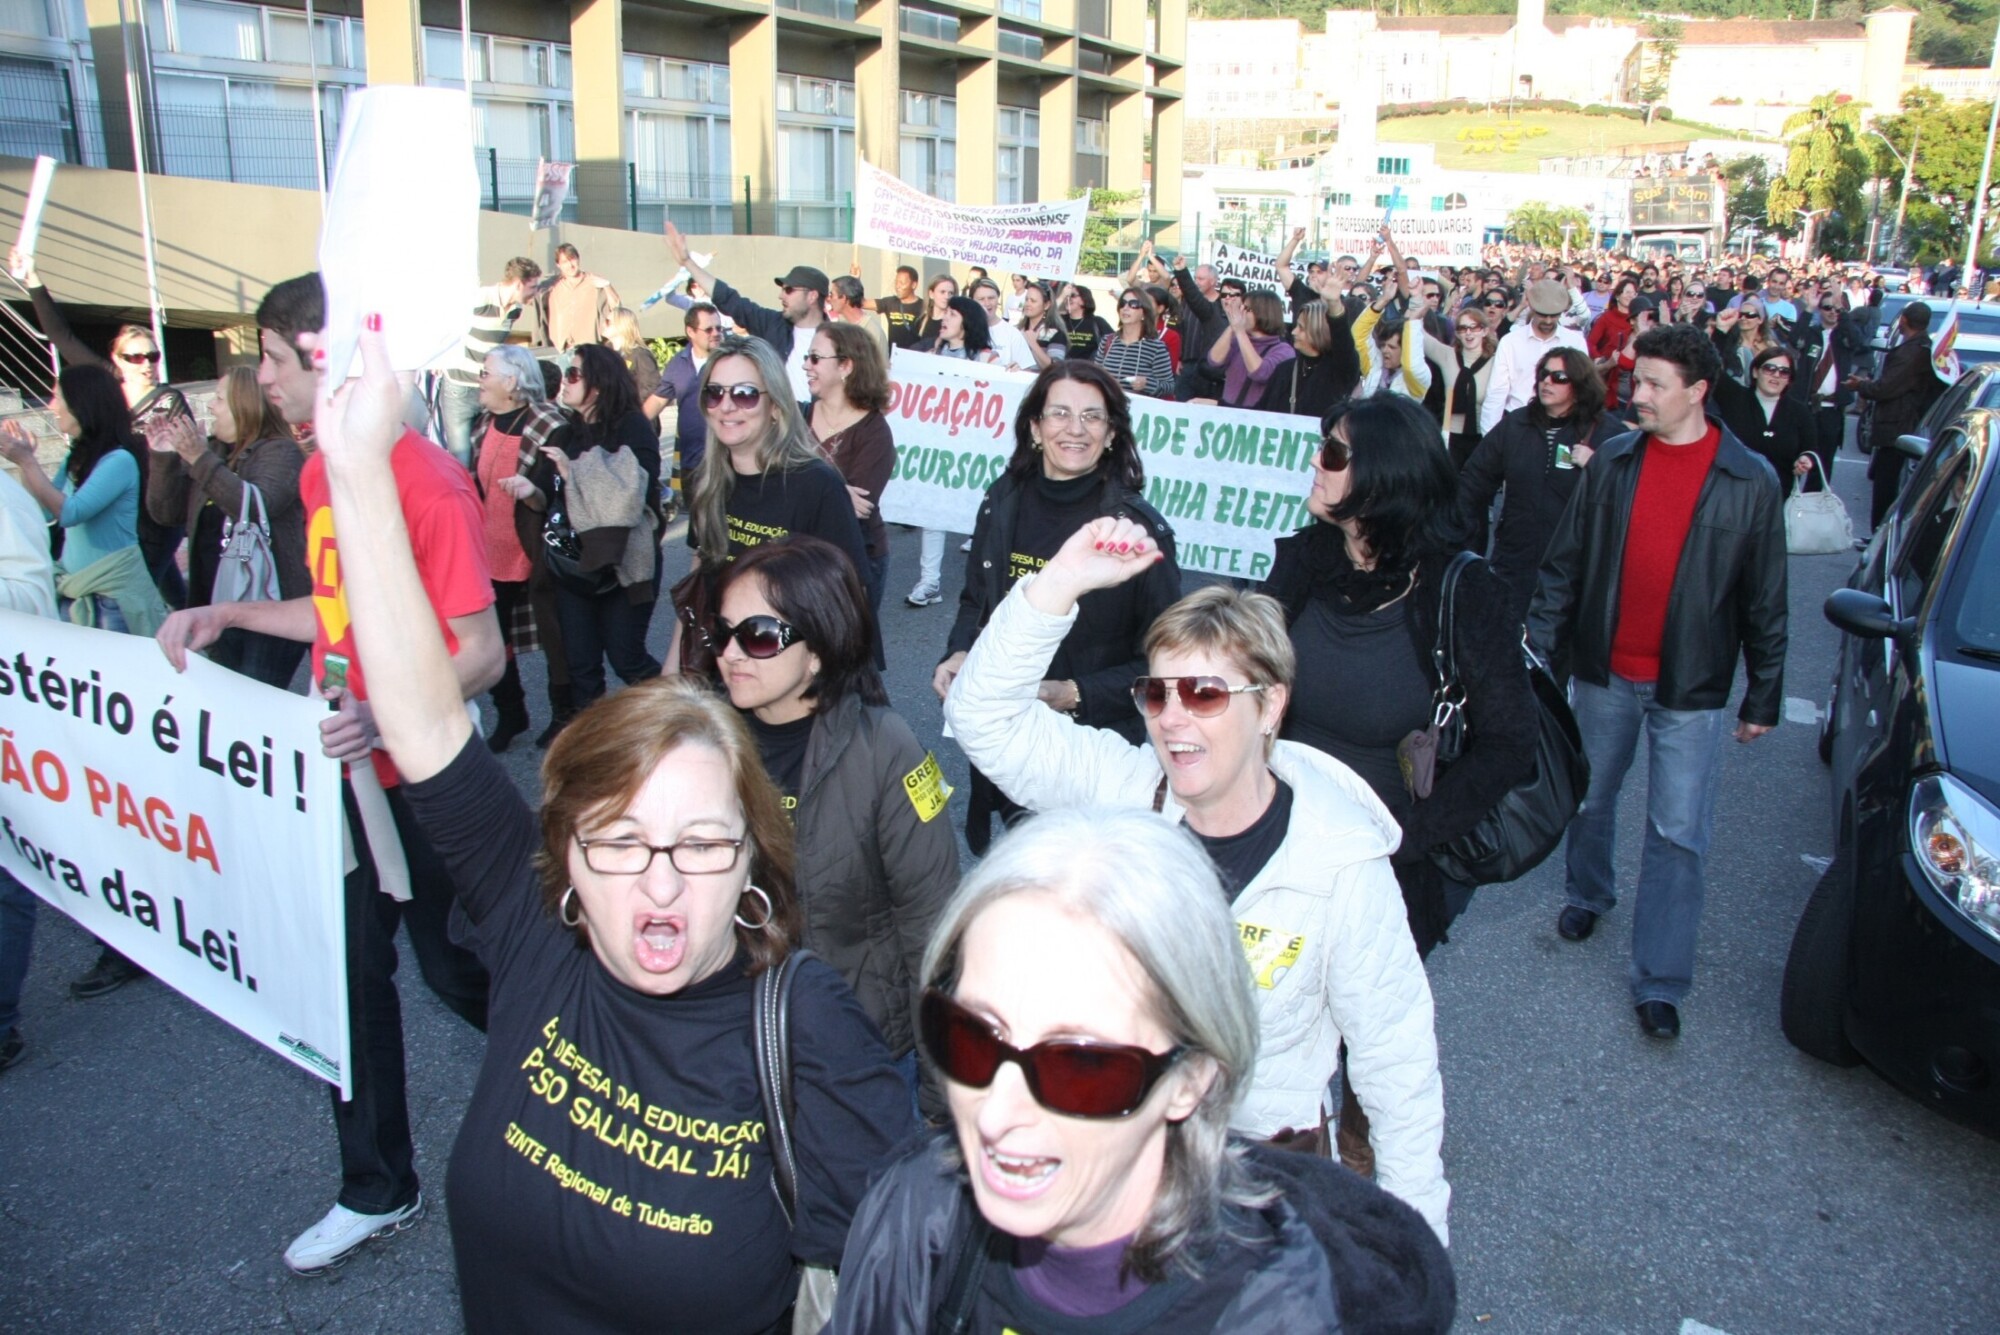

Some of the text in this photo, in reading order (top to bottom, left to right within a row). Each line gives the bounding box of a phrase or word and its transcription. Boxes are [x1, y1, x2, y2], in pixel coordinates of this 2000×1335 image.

[1364, 175, 1421, 185] QUALIFICAR
[872, 202, 890, 216] DE
[947, 222, 1005, 240] PASSANDO
[953, 213, 984, 225] POVO
[987, 213, 1070, 227] CATARINENSE
[1400, 219, 1436, 234] GETULIO
[1438, 217, 1473, 234] VARGAS
[1217, 244, 1228, 258] A
[1345, 239, 1364, 254] LUTA
[1407, 240, 1450, 256] NACIONAL
[1215, 260, 1281, 283] SALARIAL
[1135, 413, 1189, 456] ADE
[152, 695, 180, 754] é
[198, 709, 274, 798] Lei
[84, 766, 222, 875] PAGA
[101, 868, 161, 933] da
[173, 896, 258, 993] Lei.
[542, 1016, 765, 1146] E DEFESA DA EDUCAÇÃO
[521, 1046, 751, 1179] PSO SALARIAL JÁ!
[504, 1122, 713, 1236] SINTE Regional de Tubarão
